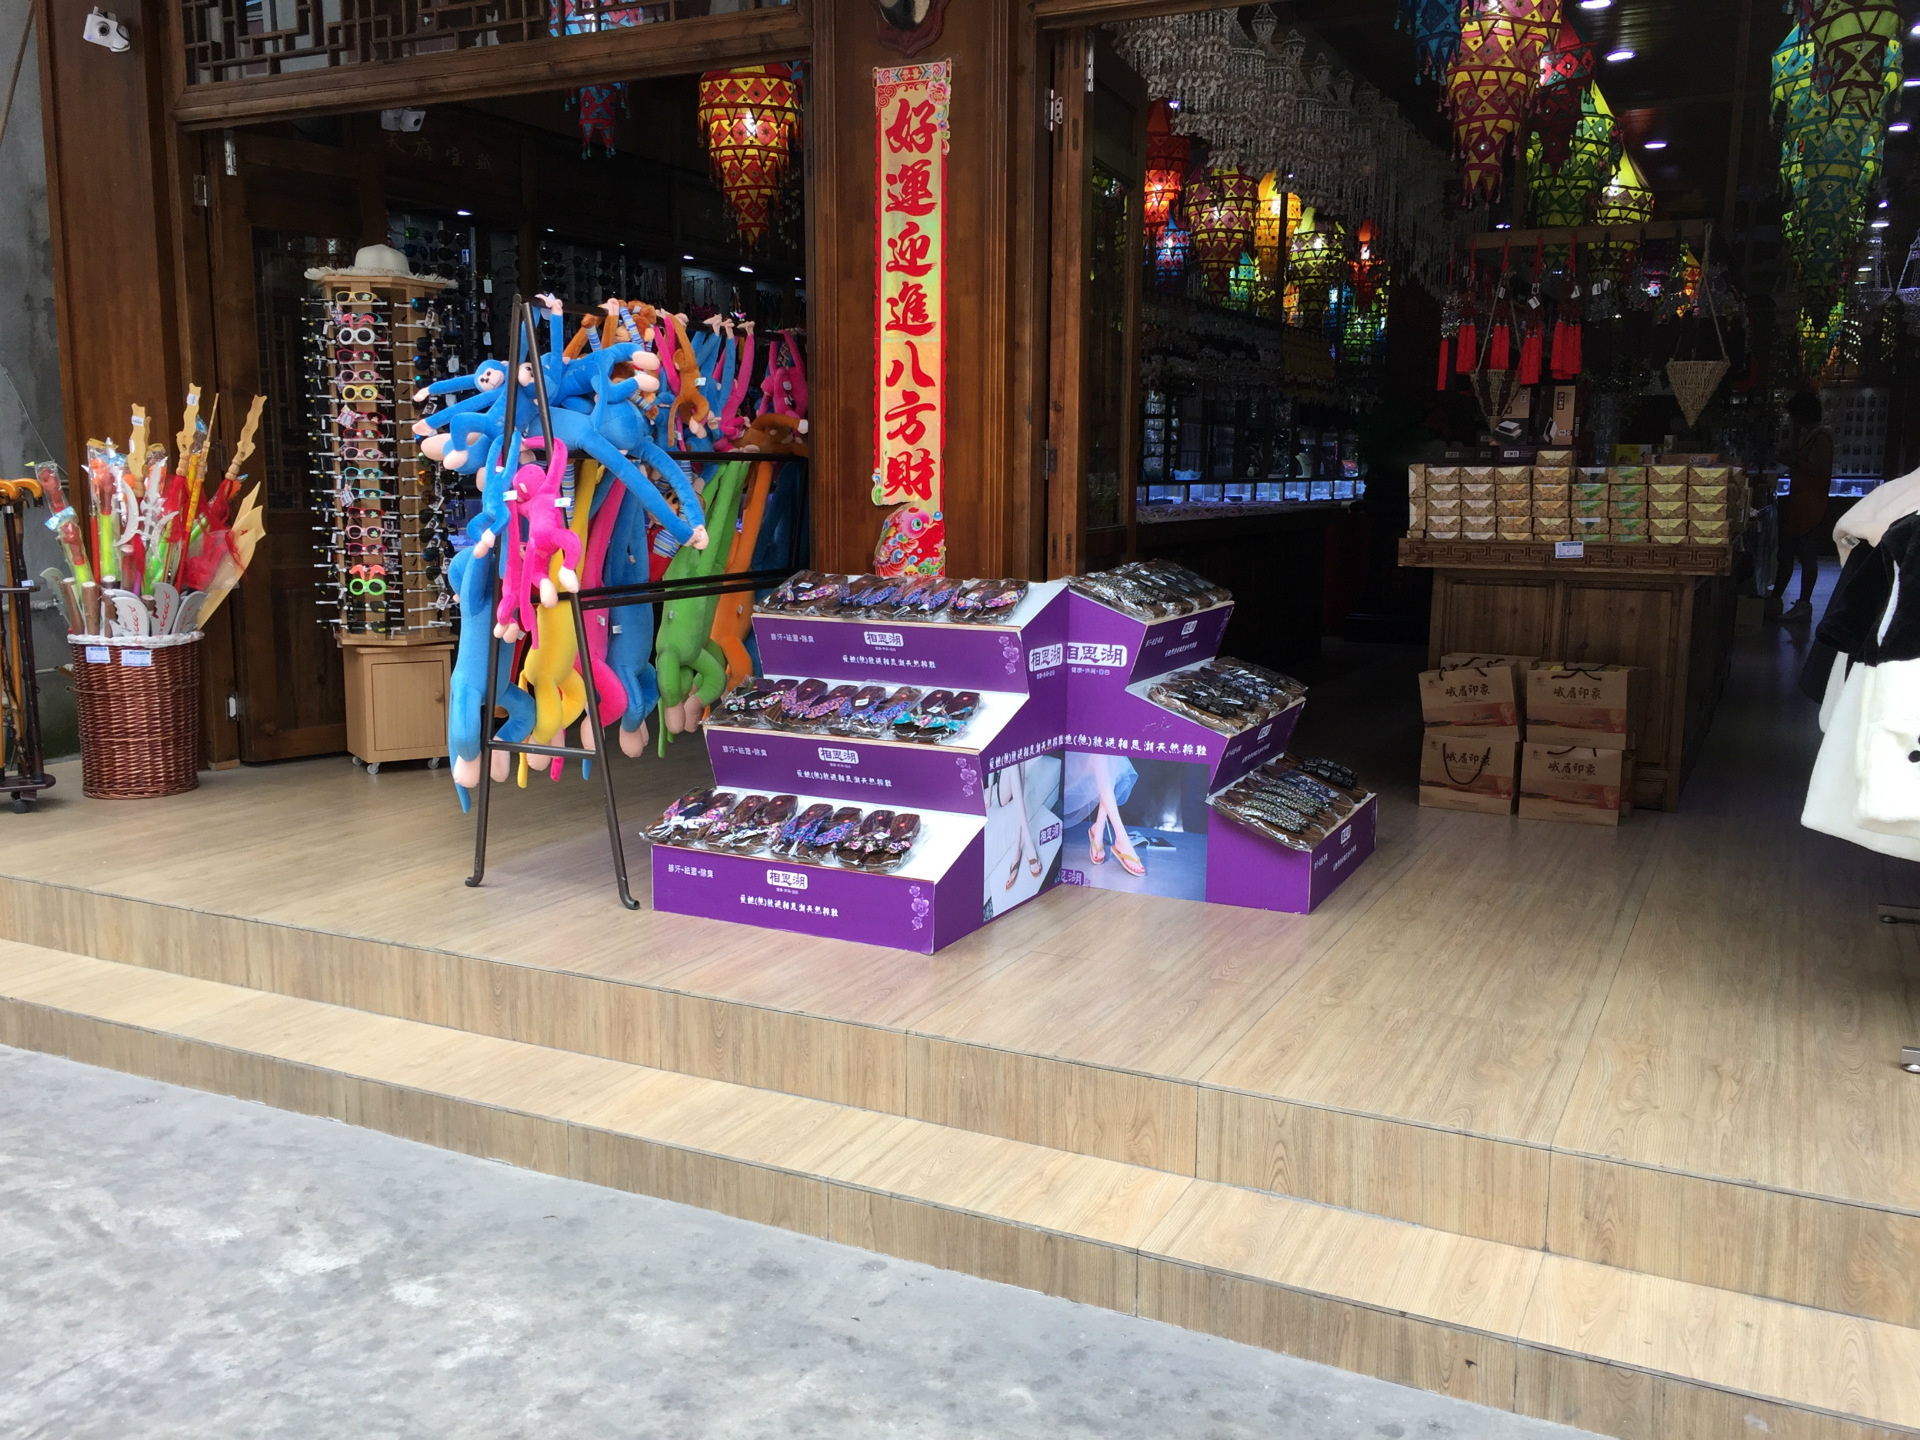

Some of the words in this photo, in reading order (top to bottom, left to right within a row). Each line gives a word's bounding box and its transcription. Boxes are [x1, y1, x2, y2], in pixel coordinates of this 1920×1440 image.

[884, 98, 938, 502] 好運迎進八方財
[866, 632, 902, 645] 相思湖
[1031, 645, 1061, 670] 相思湖
[1445, 683, 1490, 698] 峨眉印象
[1553, 686, 1601, 700] 峨眉印象
[820, 748, 858, 763] 相思湖
[1548, 761, 1596, 776] 峨眉印象
[769, 870, 806, 888] 相思湖
